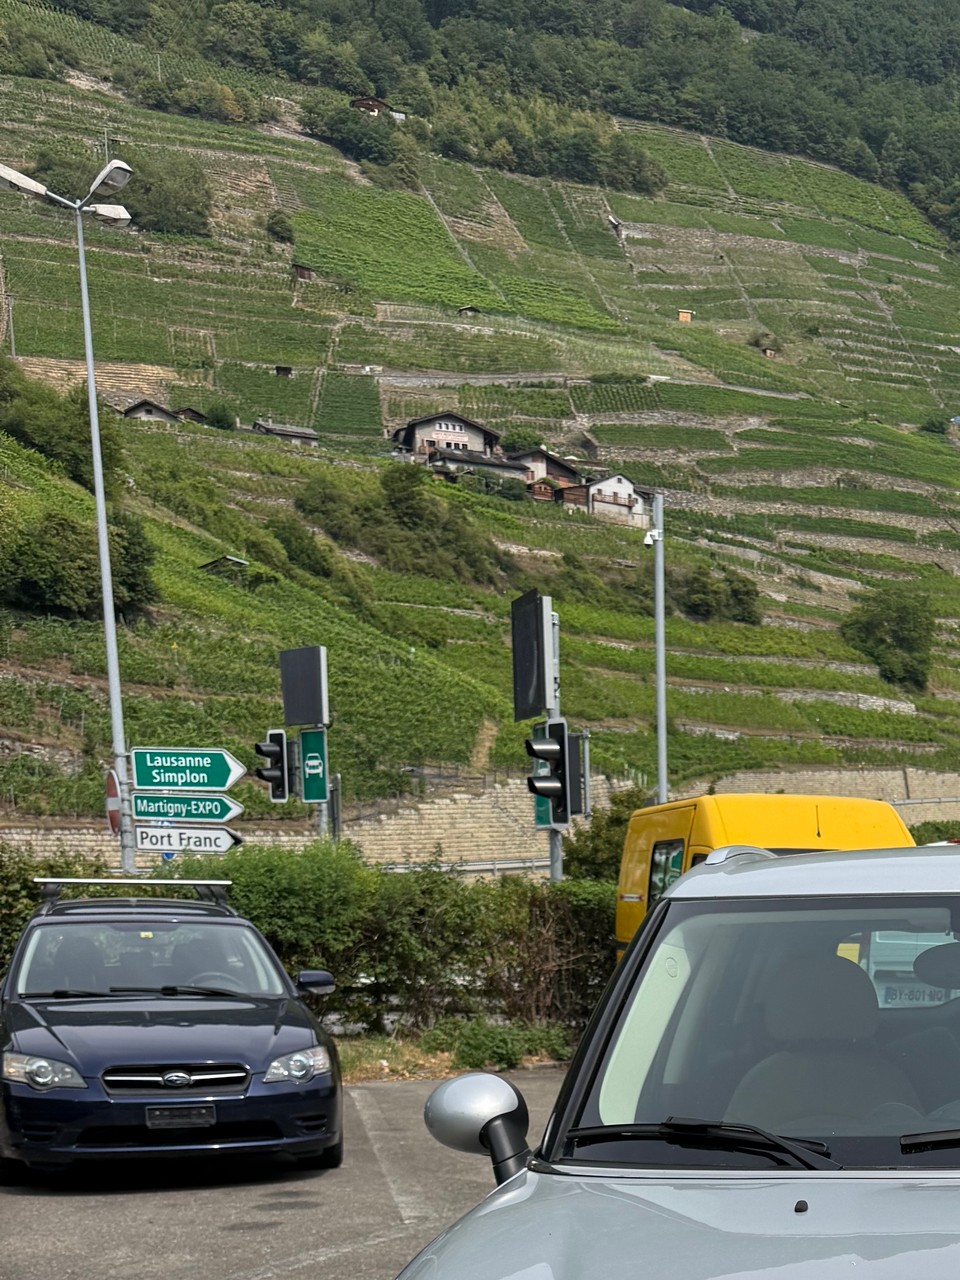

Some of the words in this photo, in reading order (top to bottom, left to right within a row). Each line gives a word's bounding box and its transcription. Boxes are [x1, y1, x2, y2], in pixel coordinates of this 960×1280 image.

[146, 753, 211, 767] Lausanne
[152, 769, 207, 785] Simplon
[137, 799, 221, 816] Martigny-EXPO
[140, 831, 173, 846] Port
[178, 832, 222, 848] Franc
